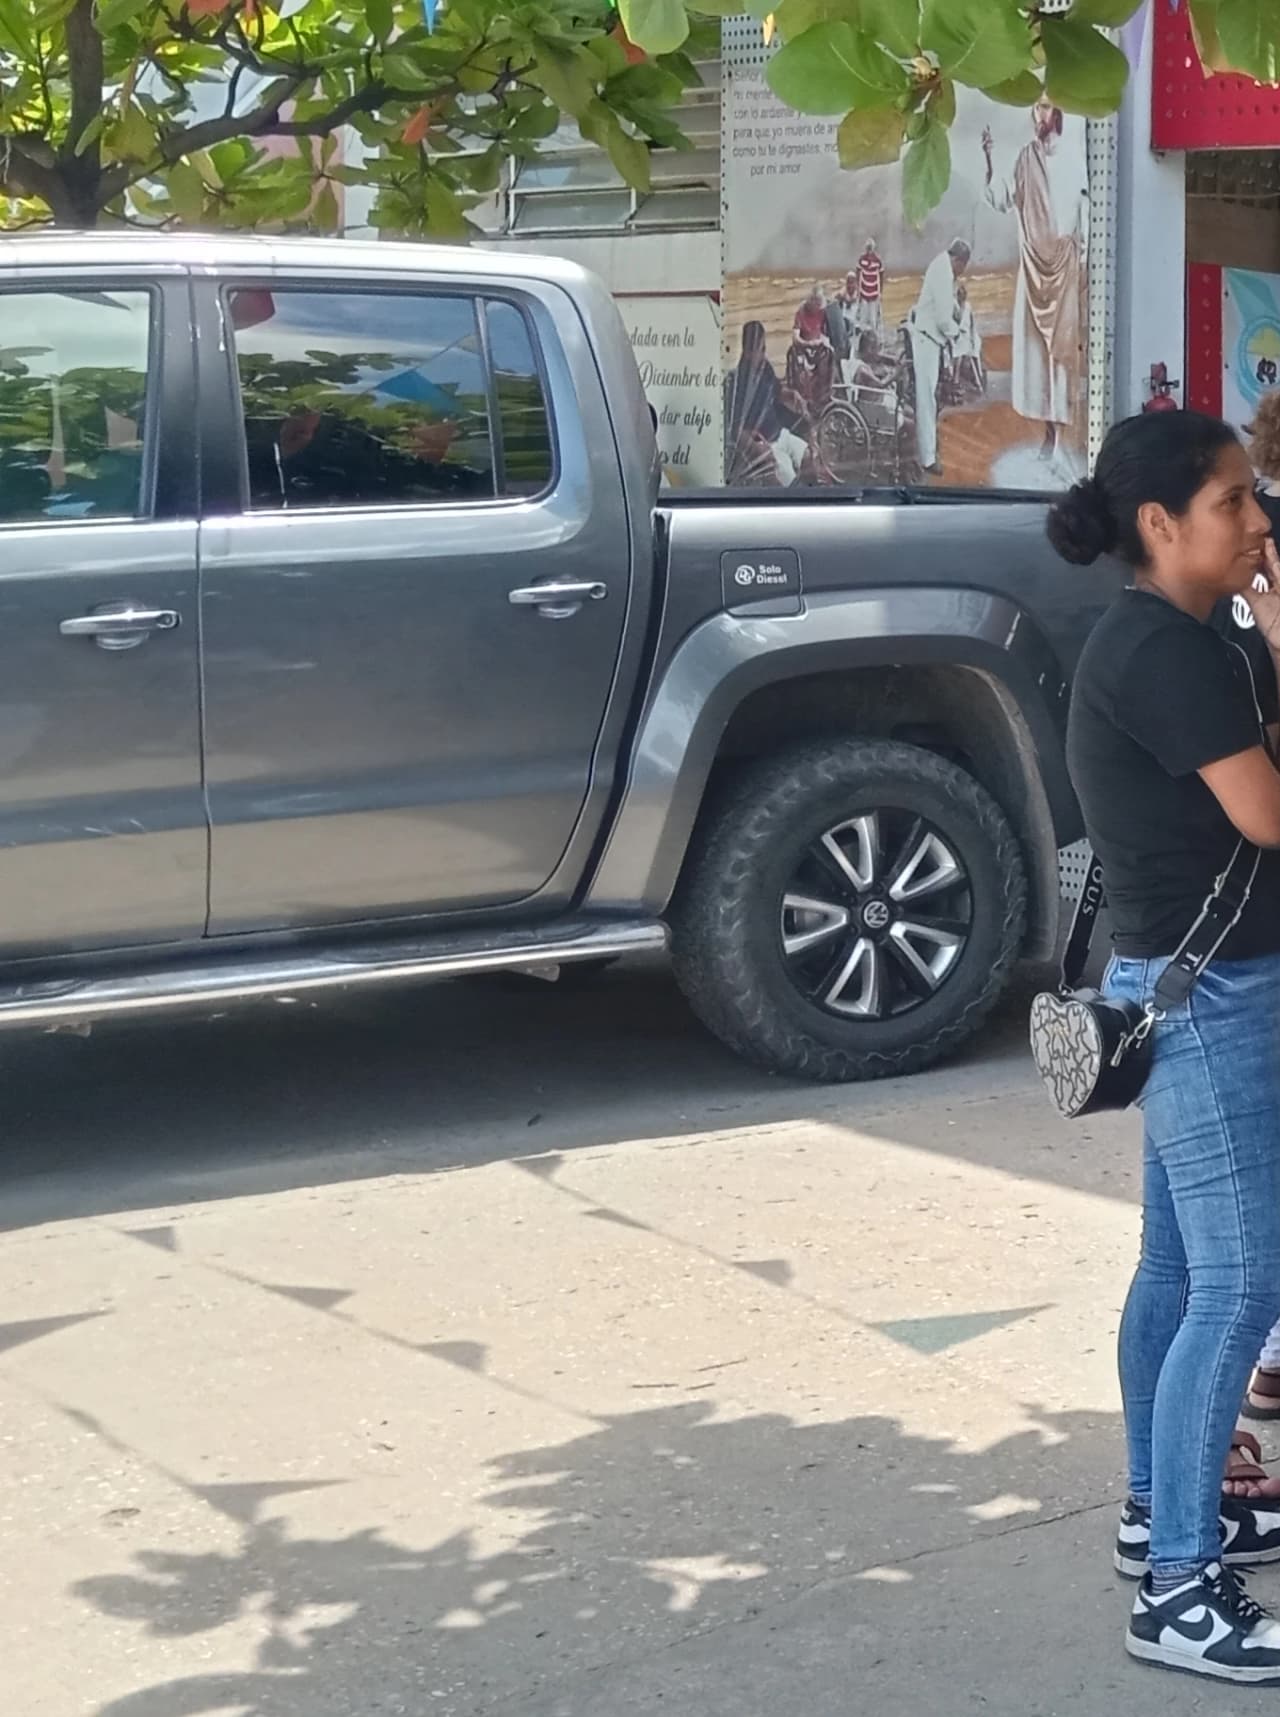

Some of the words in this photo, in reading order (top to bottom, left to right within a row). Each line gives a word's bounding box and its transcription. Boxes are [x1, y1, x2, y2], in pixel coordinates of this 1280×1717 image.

[814, 121, 825, 135] de
[732, 145, 756, 158] como
[750, 164, 764, 177] por
[766, 163, 777, 175] mi
[661, 334, 681, 347] con
[683, 325, 695, 347] la
[639, 360, 701, 389] Diciembre
[704, 366, 719, 387] de
[659, 405, 681, 426] dar
[671, 444, 691, 466] del
[756, 573, 788, 584] Diesel
